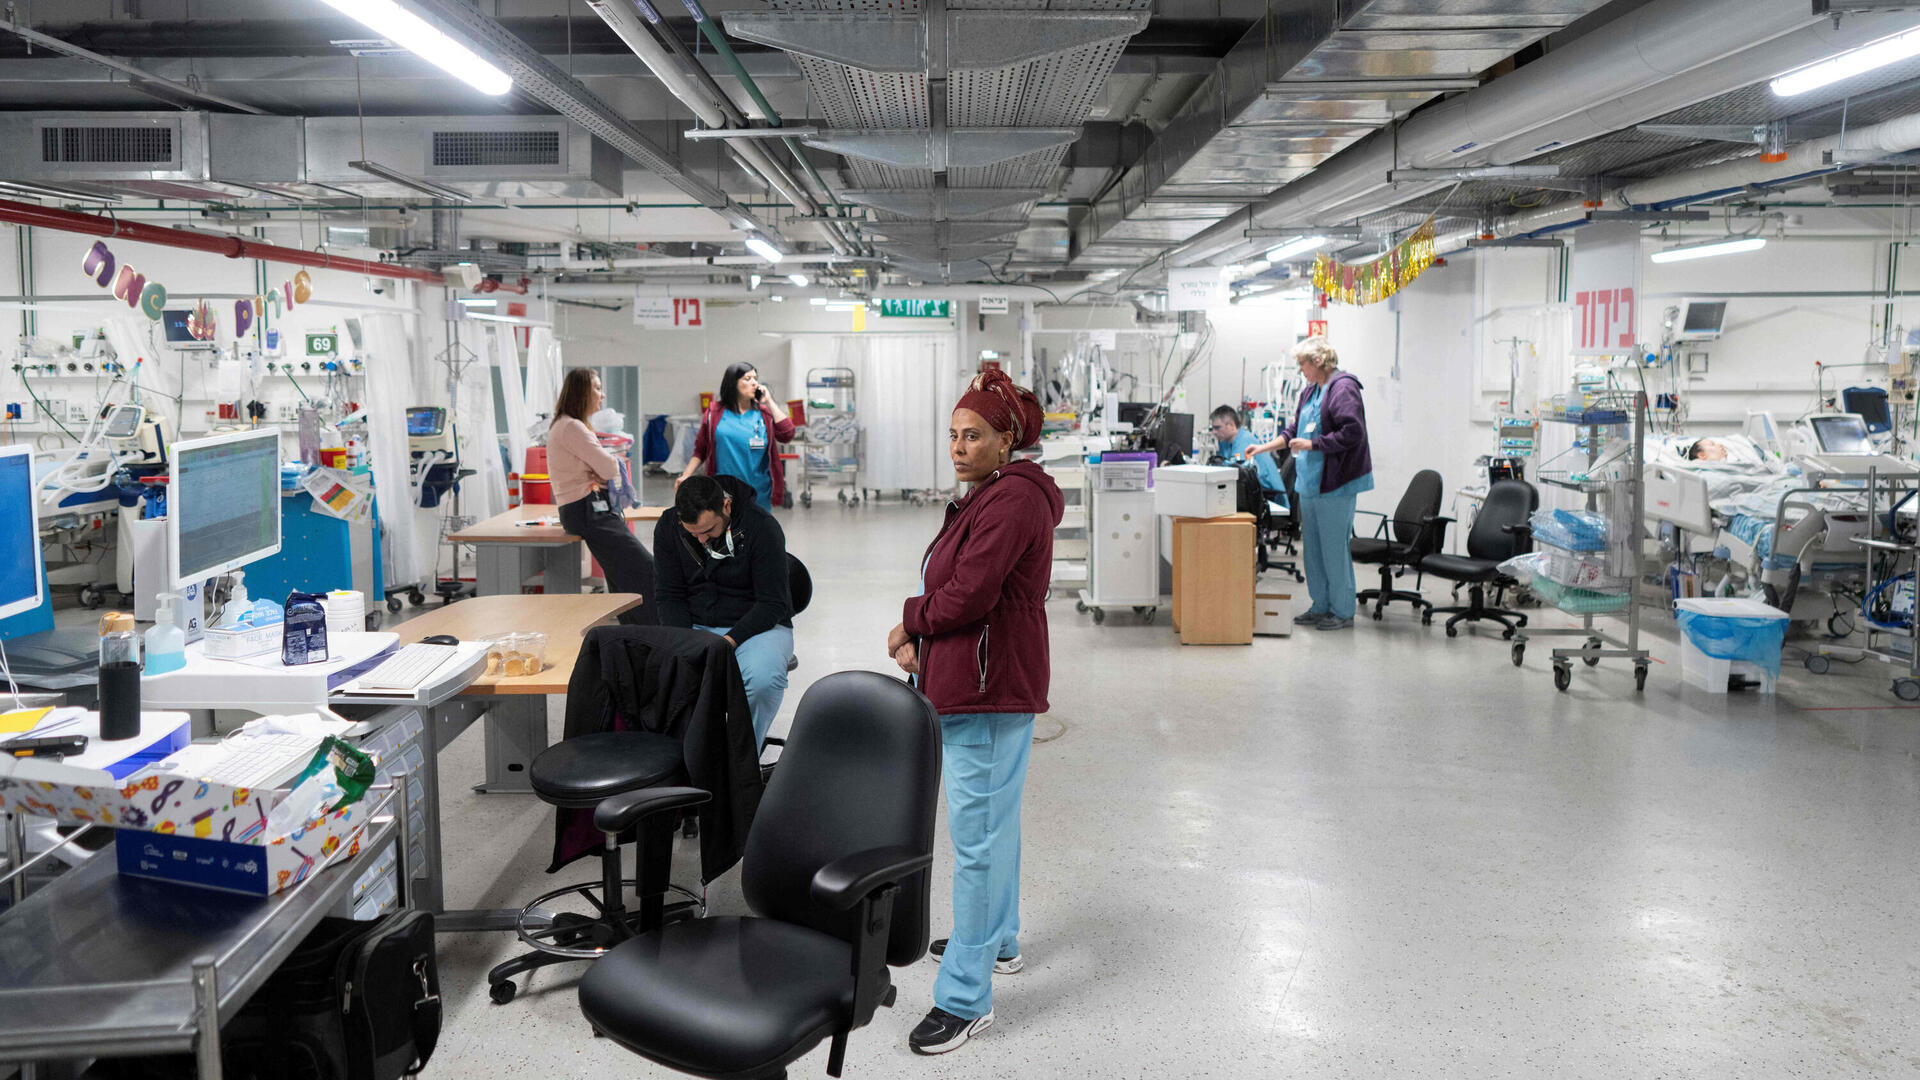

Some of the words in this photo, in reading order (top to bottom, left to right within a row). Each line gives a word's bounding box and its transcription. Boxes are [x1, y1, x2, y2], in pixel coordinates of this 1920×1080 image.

[982, 296, 1007, 304] יציאה
[673, 298, 702, 326] בין
[1576, 287, 1635, 348] בידוד
[313, 337, 331, 351] 69
